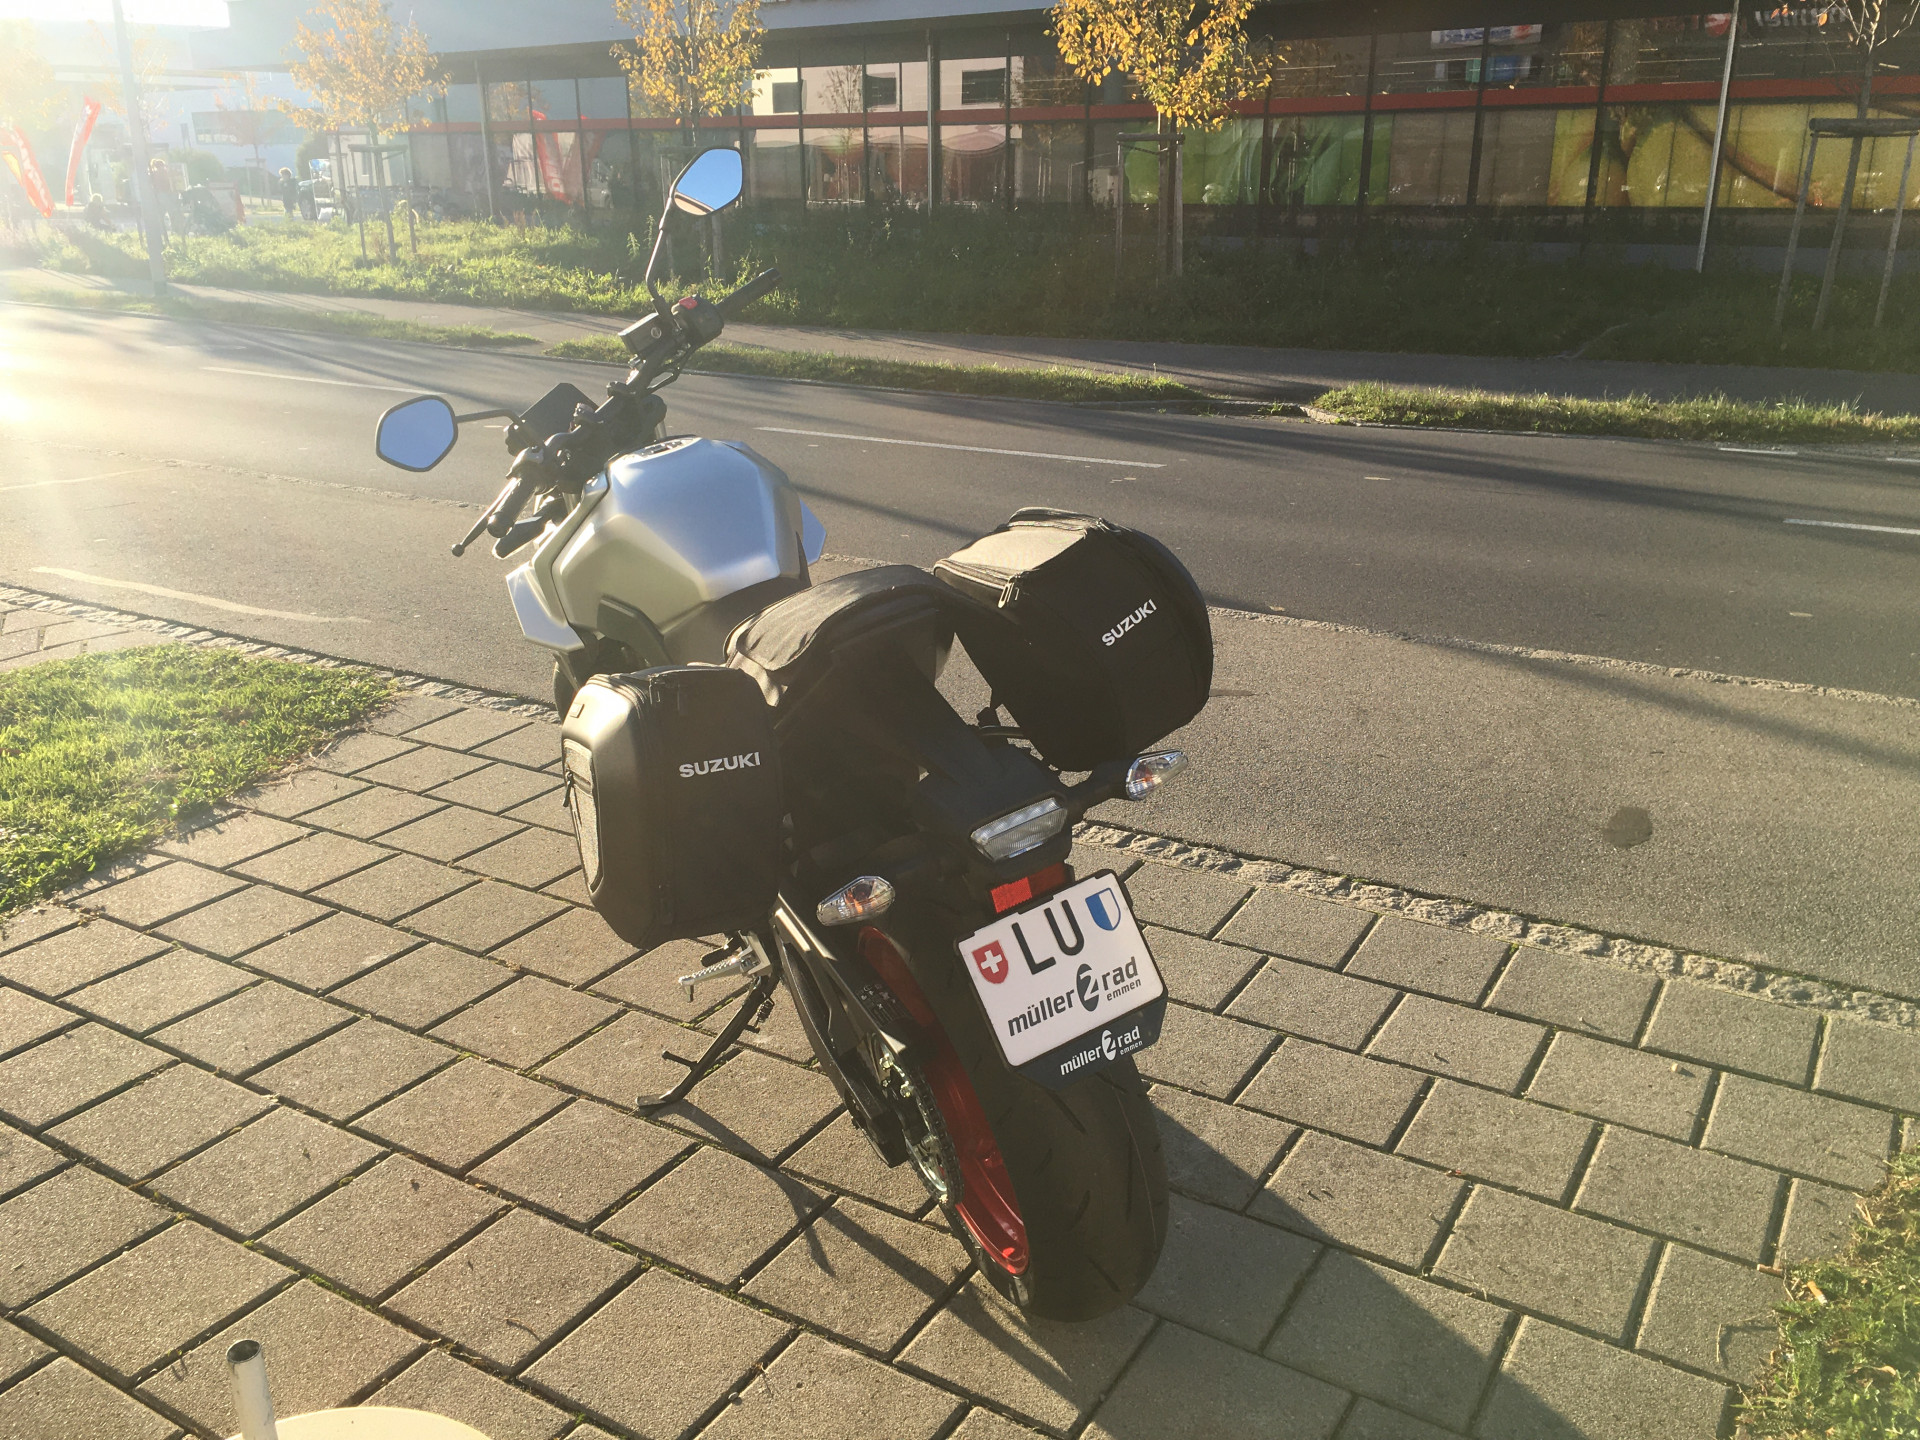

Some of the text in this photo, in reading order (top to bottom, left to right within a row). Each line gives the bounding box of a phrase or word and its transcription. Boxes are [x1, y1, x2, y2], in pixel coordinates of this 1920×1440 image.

[1101, 598, 1157, 647] SUZUKI
[679, 751, 761, 778] SUZUKI
[1011, 899, 1085, 975] LU
[1106, 977, 1142, 1002] emmen
[1007, 988, 1075, 1037] müller
[1060, 1045, 1102, 1076] müller
[1119, 1040, 1143, 1056] emmen
